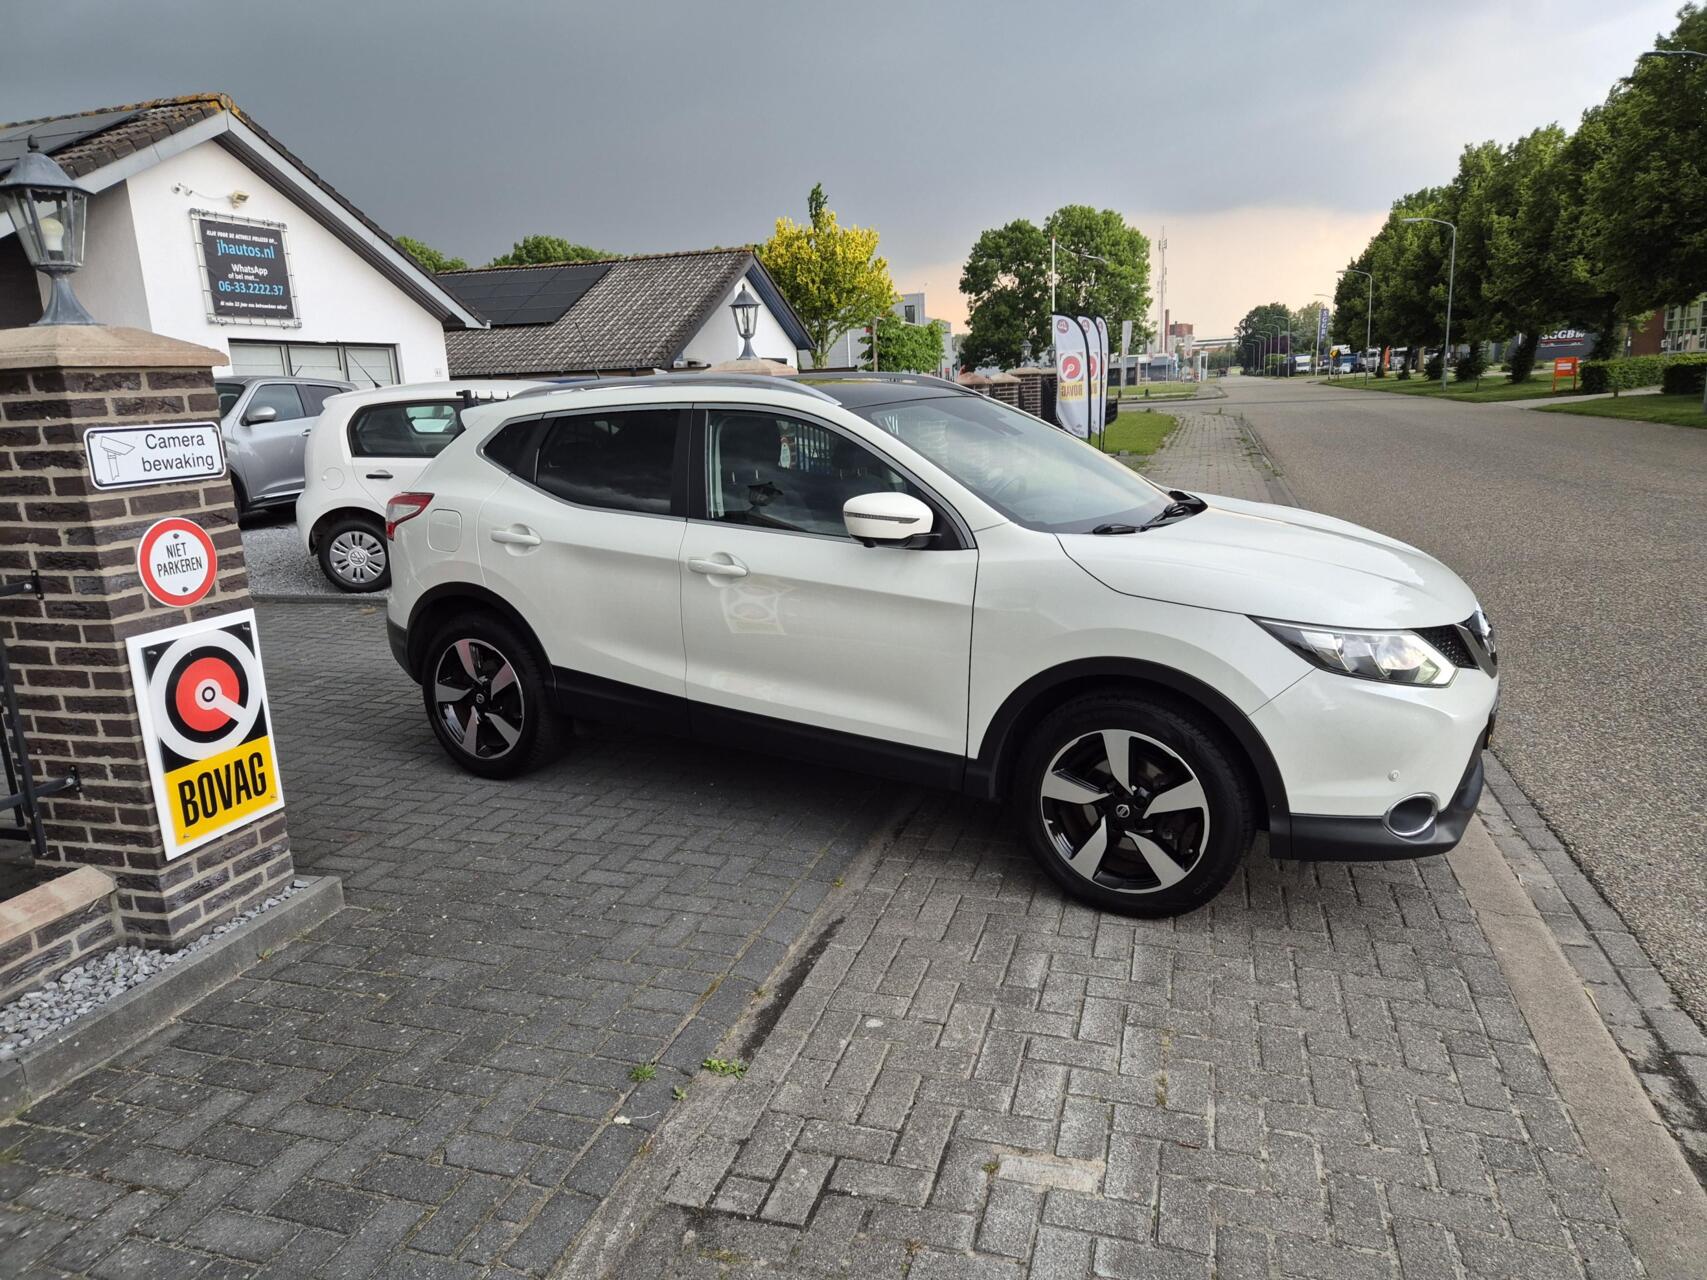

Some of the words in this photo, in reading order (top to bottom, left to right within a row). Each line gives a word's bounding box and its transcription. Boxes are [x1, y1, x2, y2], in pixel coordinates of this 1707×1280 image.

[217, 240, 274, 258] jhautos.nl
[231, 263, 268, 276] WhatsApp
[218, 280, 284, 296] 06-33.2222.37
[145, 433, 205, 450] Camera
[141, 453, 215, 472] bewaking
[166, 542, 187, 559] NIET
[156, 556, 203, 578] PARKEREN
[178, 751, 267, 828] BOVAG
